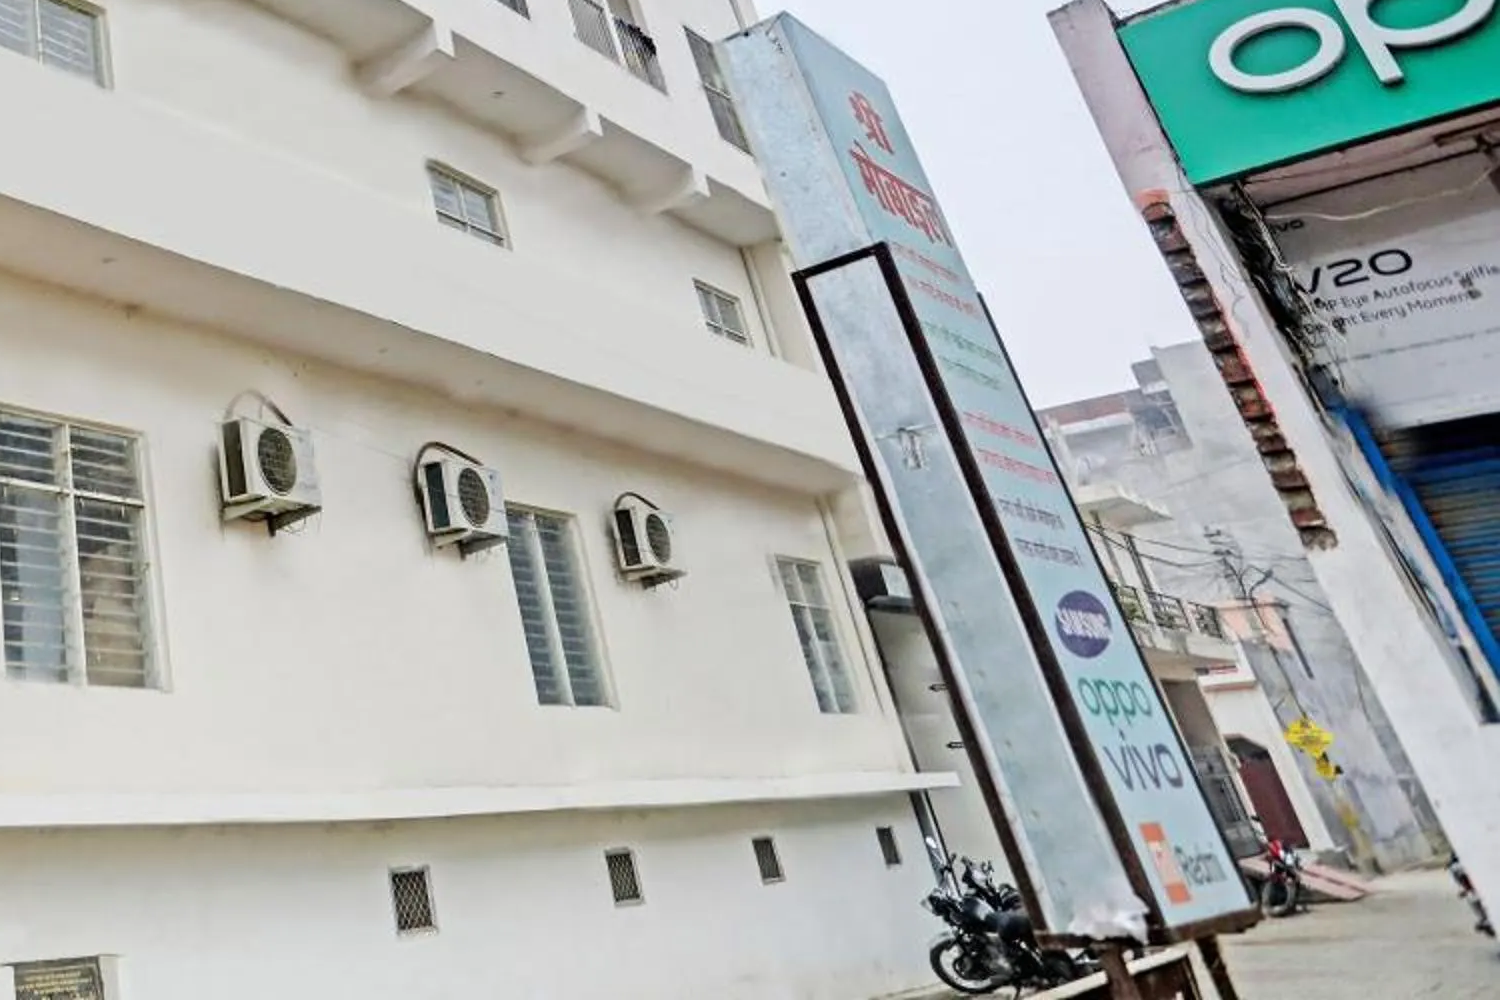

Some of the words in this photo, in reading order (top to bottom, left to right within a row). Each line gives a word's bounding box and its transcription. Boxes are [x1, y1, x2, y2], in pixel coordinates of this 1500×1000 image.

[1372, 275, 1454, 301] Autofocus
[1359, 302, 1407, 324] Every
[1077, 677, 1152, 728] oppo
[1102, 730, 1184, 792] vivo
